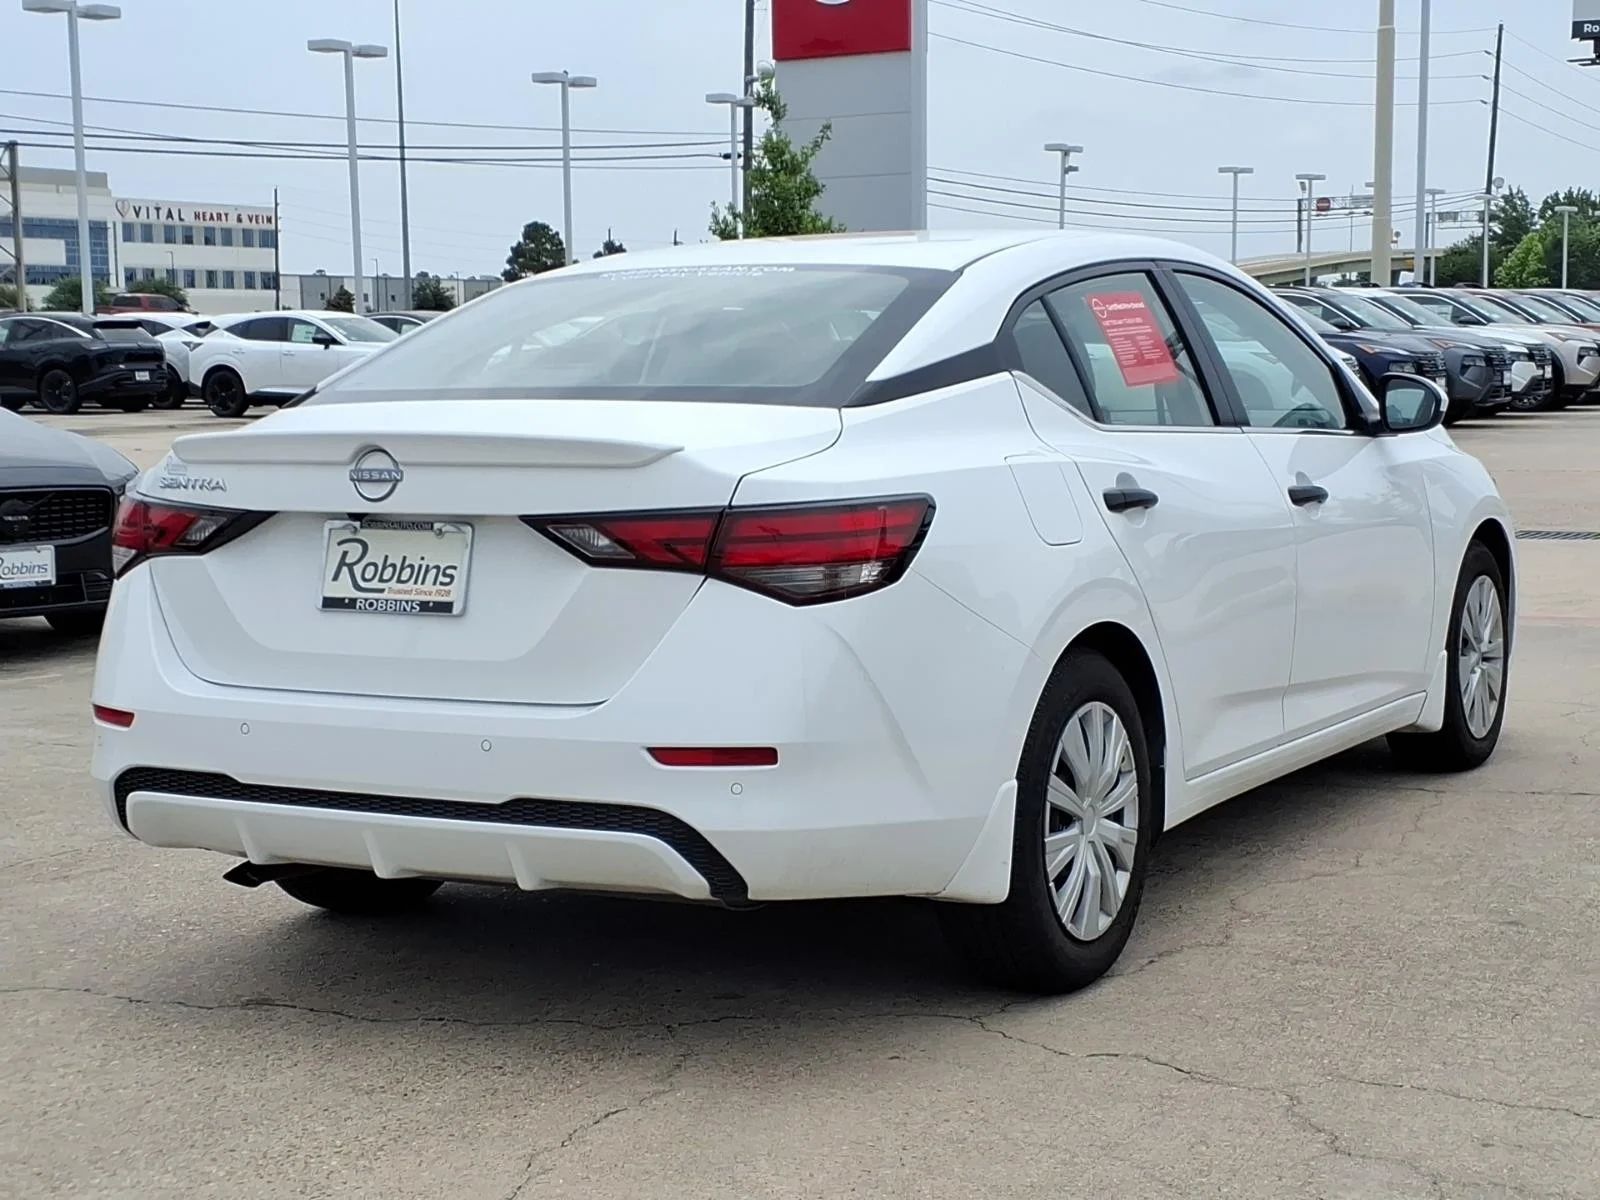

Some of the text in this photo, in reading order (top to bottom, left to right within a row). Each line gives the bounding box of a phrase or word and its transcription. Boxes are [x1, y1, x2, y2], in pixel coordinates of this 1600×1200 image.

[133, 205, 273, 225] VITAL HEART & VEIN
[350, 470, 402, 481] NISSAN
[159, 476, 227, 493] SENTRA
[331, 537, 458, 594] Robbins
[355, 598, 421, 613] ROBBINS
